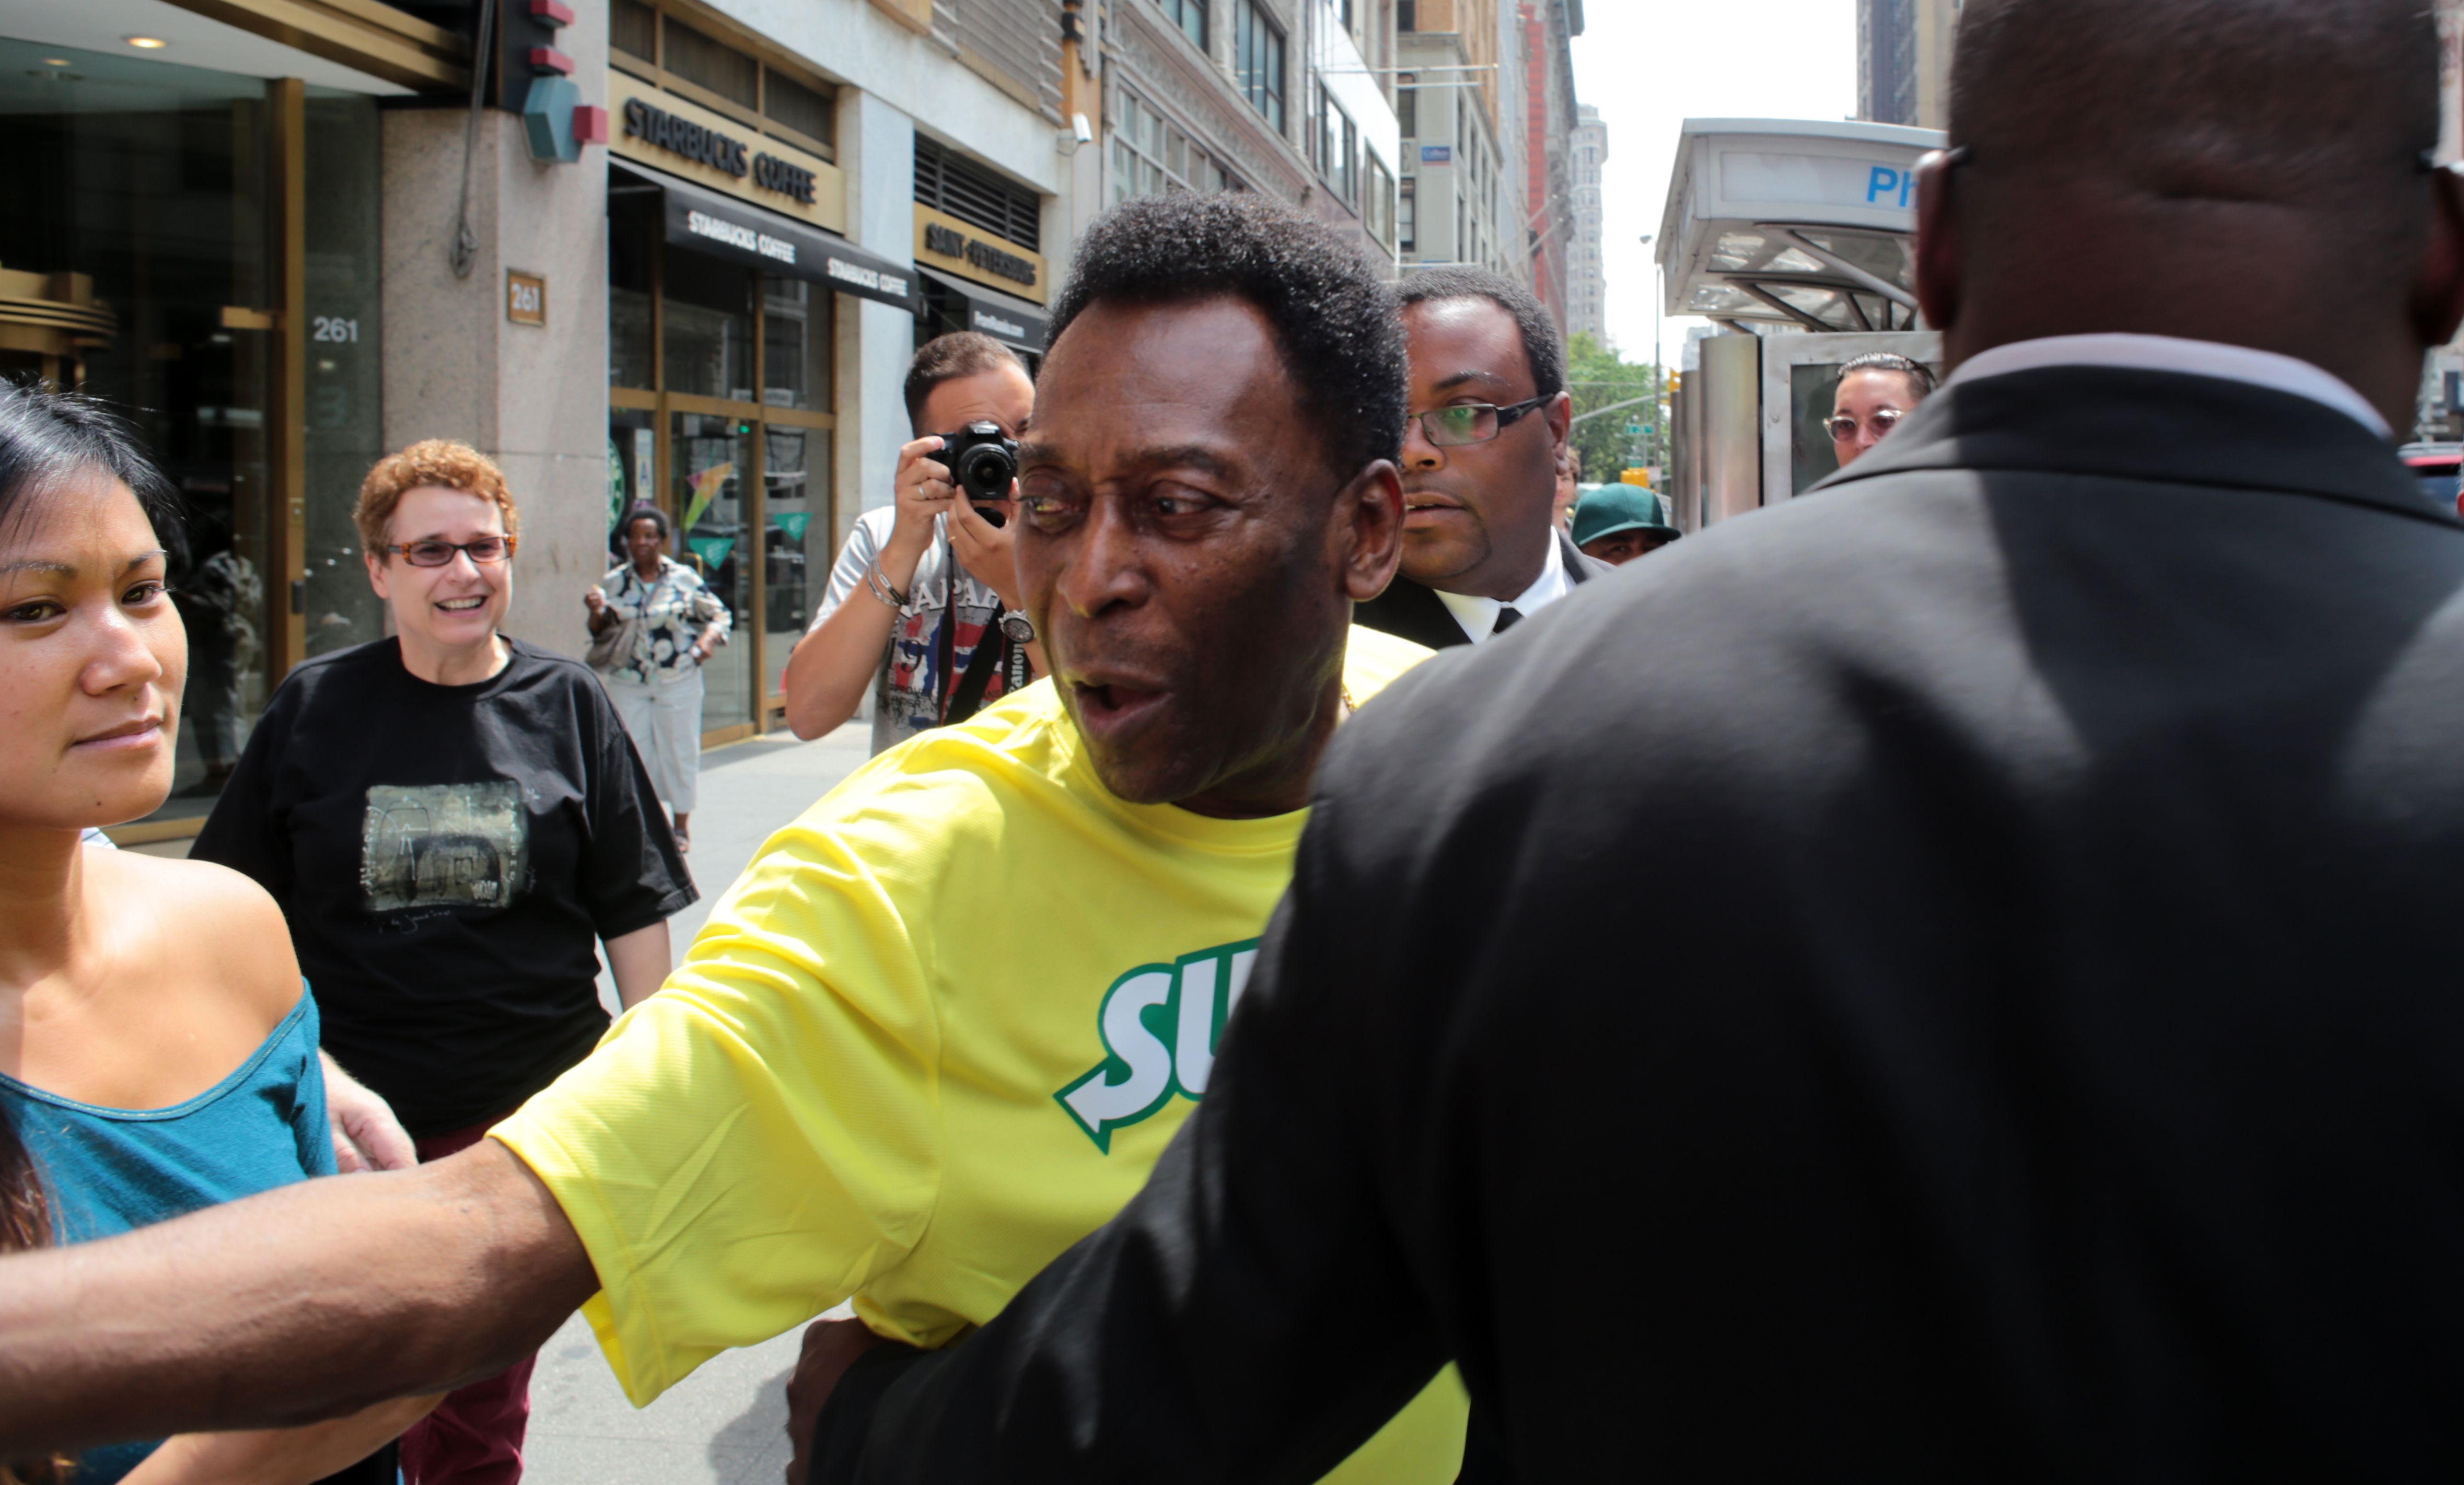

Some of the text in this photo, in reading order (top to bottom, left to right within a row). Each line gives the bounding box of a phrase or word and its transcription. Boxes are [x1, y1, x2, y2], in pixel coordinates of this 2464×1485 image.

[623, 97, 817, 204] STARBUCKS COFFEE
[688, 211, 795, 264] STARBUCKS COFFEE
[828, 258, 908, 297] STARBUCKS COFFEE
[512, 284, 540, 312] 261
[313, 317, 358, 343] 261
